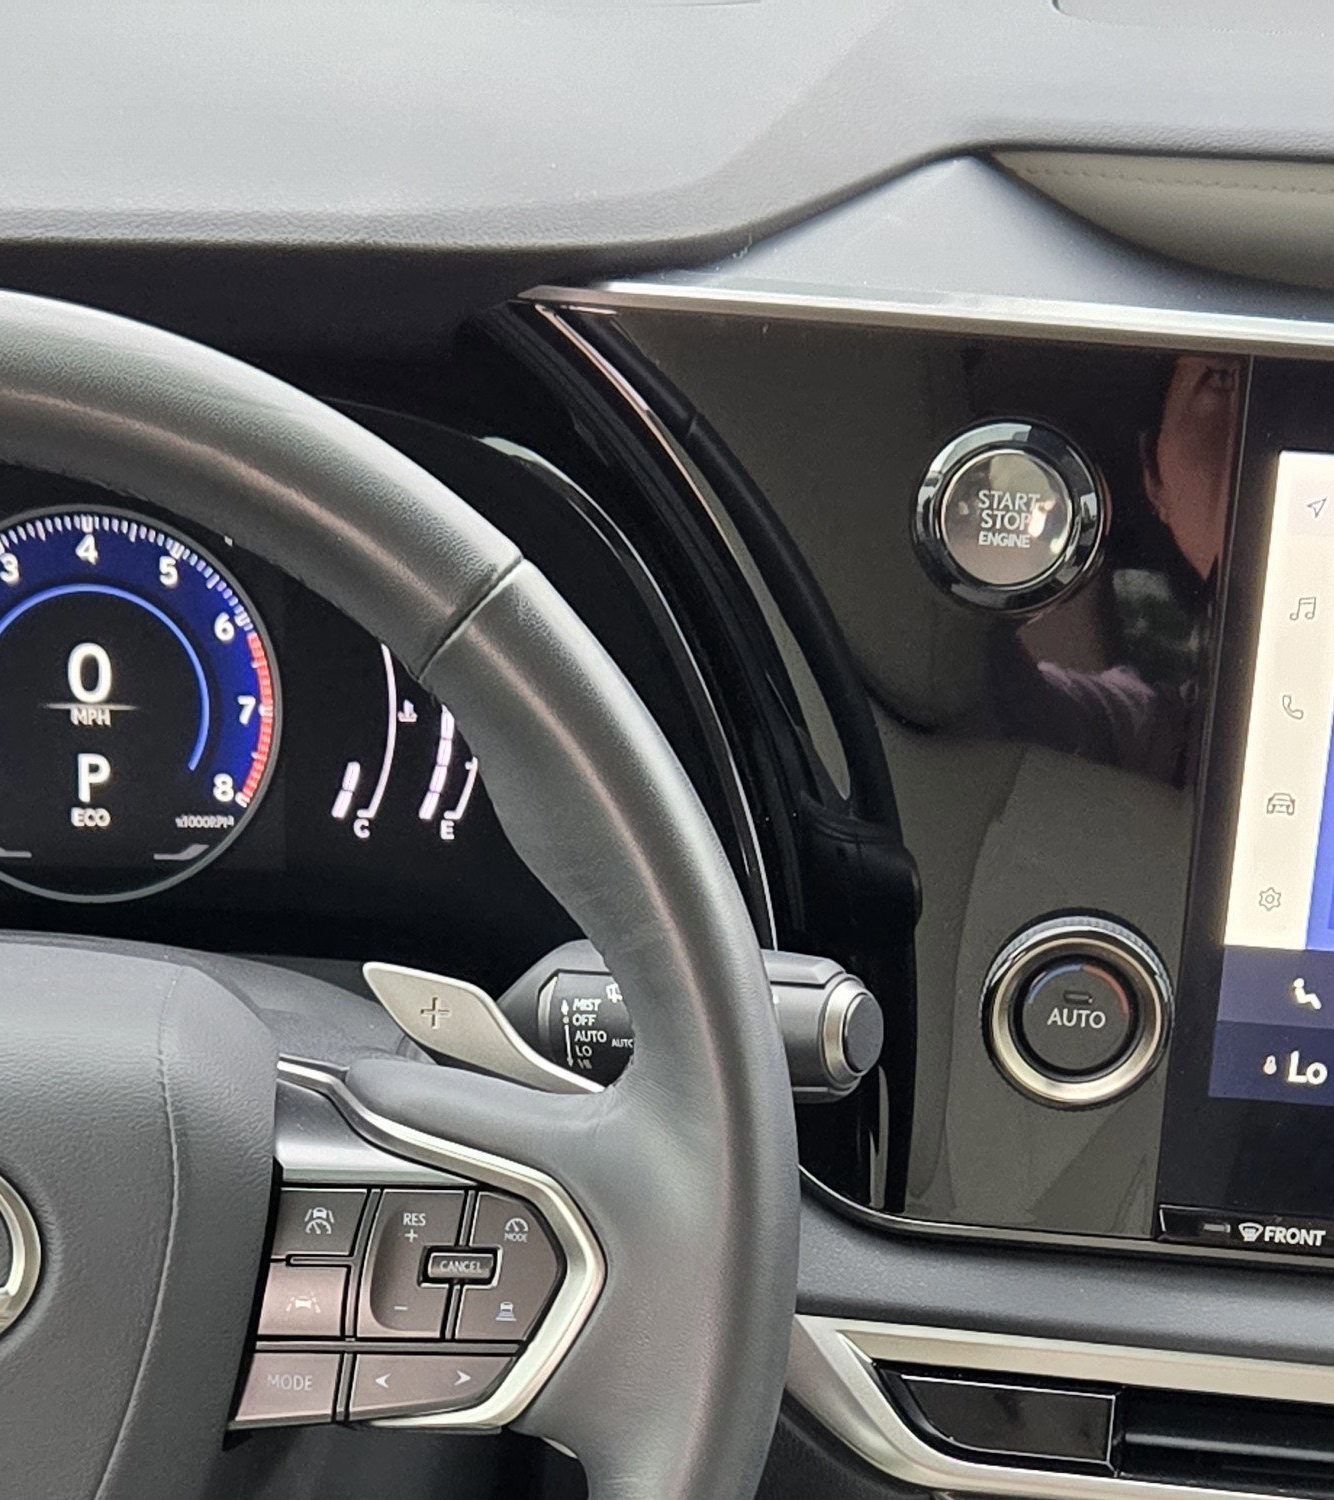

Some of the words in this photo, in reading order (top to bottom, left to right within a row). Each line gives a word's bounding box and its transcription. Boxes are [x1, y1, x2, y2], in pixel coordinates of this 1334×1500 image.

[978, 490, 1040, 511] START
[980, 510, 1032, 531] STOP
[76, 535, 97, 565] 4
[978, 531, 1030, 548] ENGINE
[0, 554, 20, 585] 3
[159, 557, 178, 587] 5
[214, 613, 234, 642] 6
[67, 643, 112, 703] 0
[70, 708, 111, 726] MPH
[237, 695, 255, 725] 7
[77, 753, 111, 802] P
[213, 774, 234, 801] 8
[71, 808, 110, 827] ECO
[353, 818, 370, 839] C
[440, 819, 455, 840] E
[572, 998, 602, 1011] MIST
[572, 1013, 597, 1026] OFF
[1047, 1008, 1106, 1029] AUTO
[574, 1030, 607, 1043] AUTO
[575, 1045, 593, 1057] LO
[1287, 1050, 1328, 1085] Lo
[403, 1213, 426, 1226] RES
[504, 1232, 528, 1243] MODE
[1264, 1226, 1327, 1246] FRONT
[439, 1260, 484, 1274] CANCEL
[267, 1374, 313, 1391] MODE
